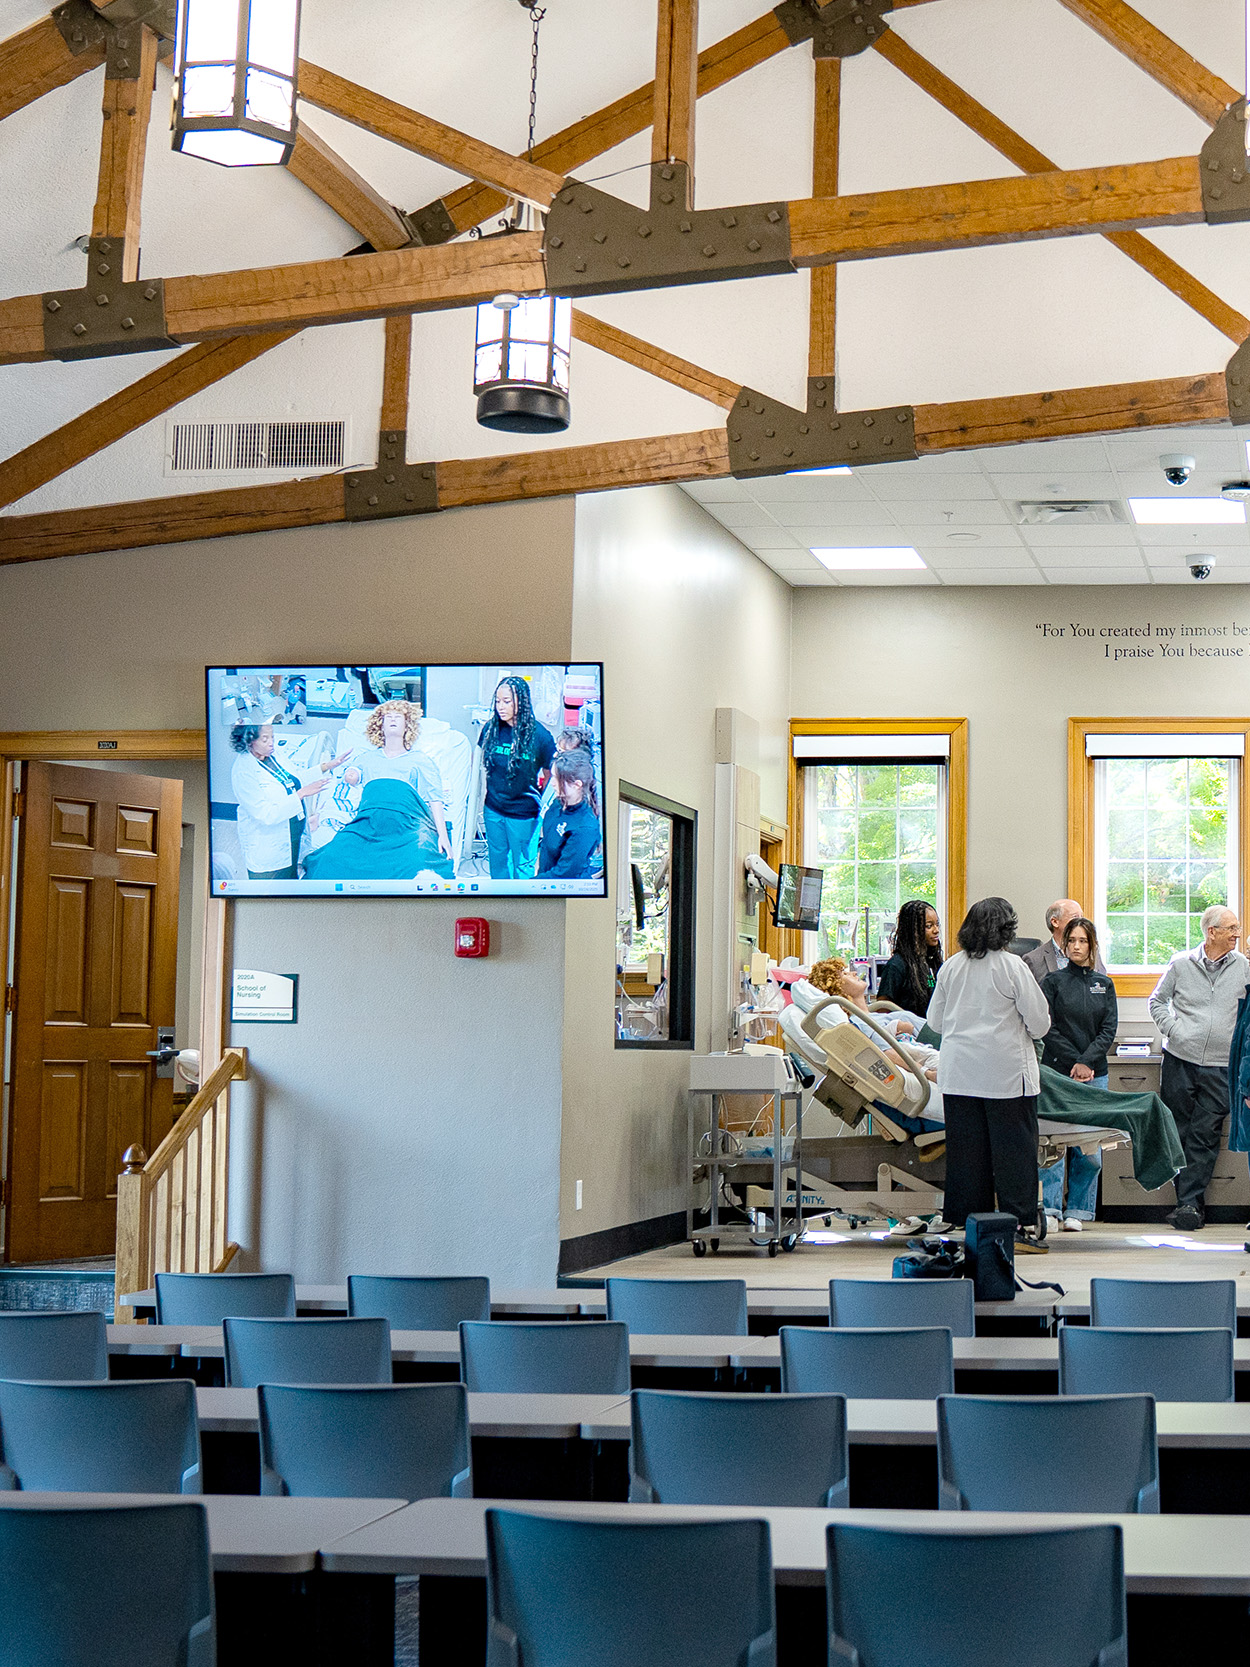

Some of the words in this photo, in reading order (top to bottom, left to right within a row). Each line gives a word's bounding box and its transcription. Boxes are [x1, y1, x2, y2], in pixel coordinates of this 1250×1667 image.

[1035, 623, 1066, 637] “For
[1069, 623, 1095, 637] You
[1099, 622, 1151, 637] created
[1155, 627, 1176, 639] my
[1180, 623, 1228, 637] inmost
[1104, 643, 1110, 658] I
[1114, 645, 1155, 661] praise
[1159, 643, 1184, 658] You
[1189, 642, 1244, 657] because
